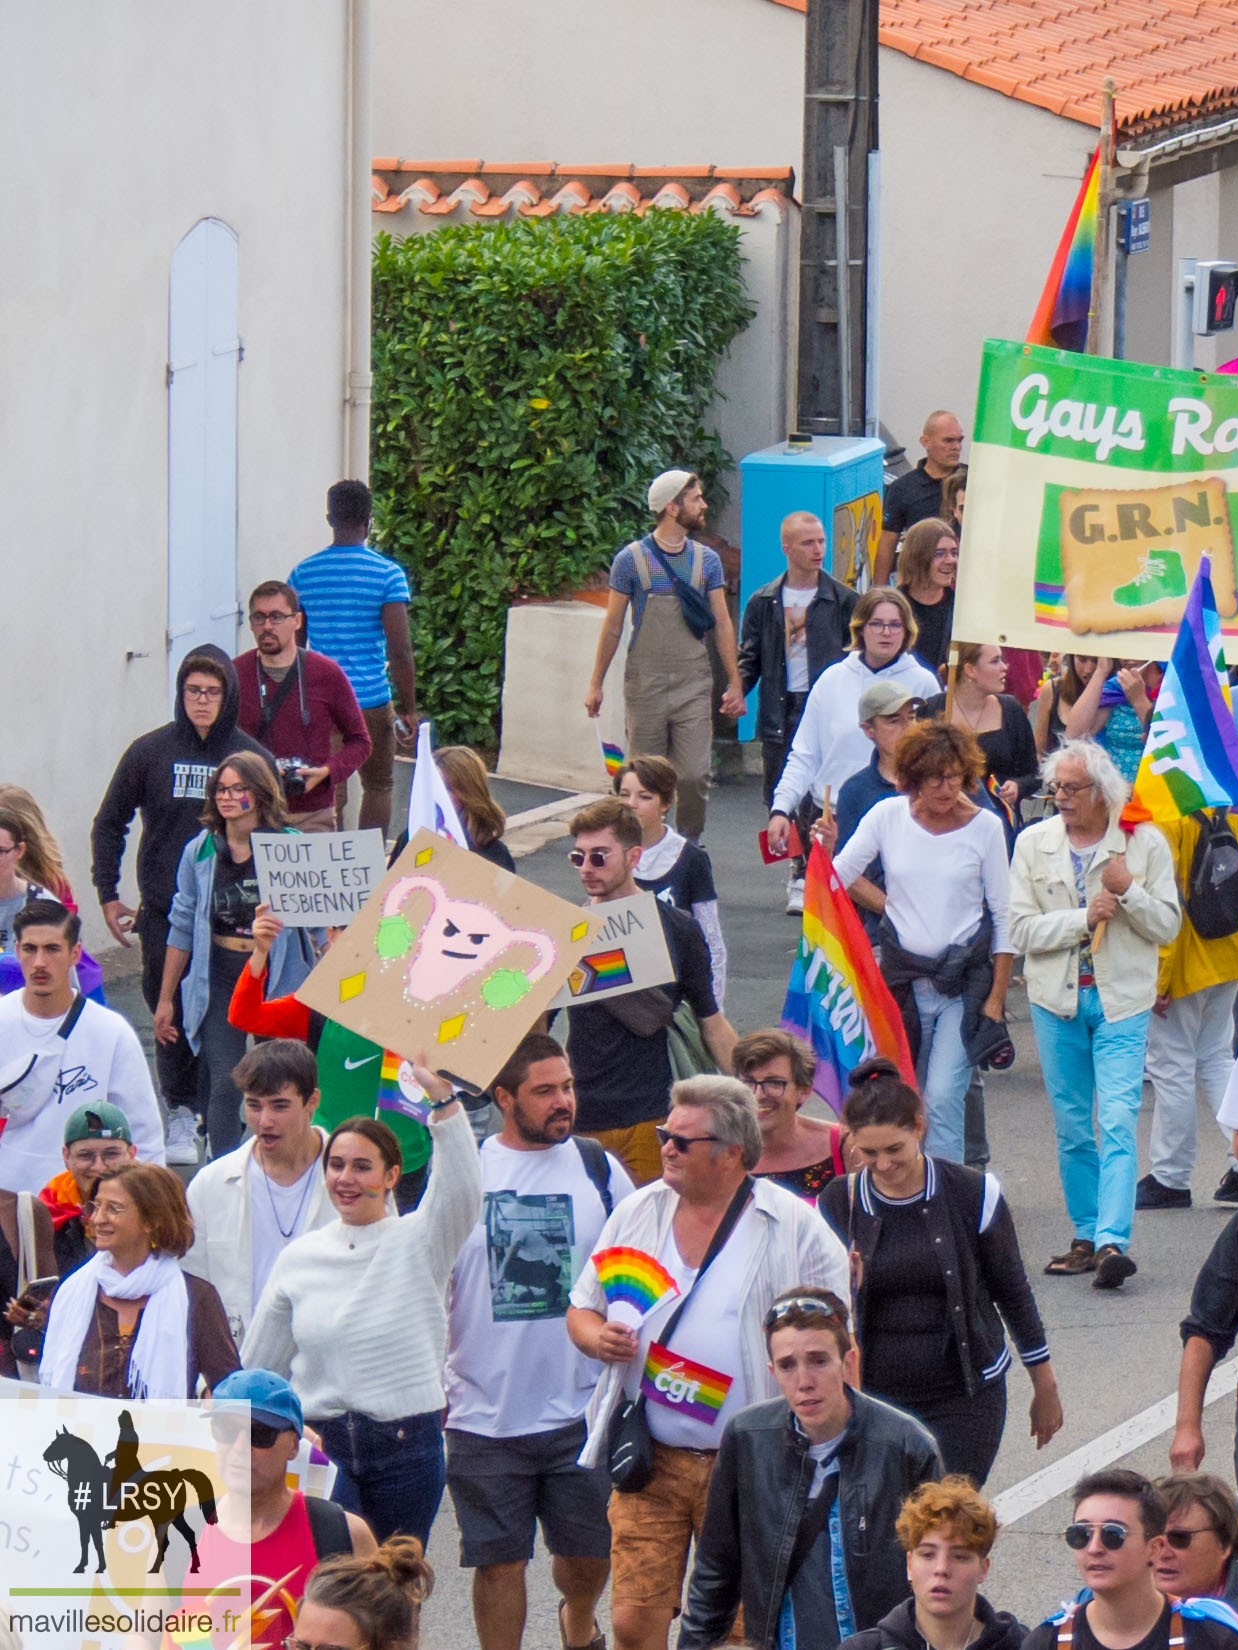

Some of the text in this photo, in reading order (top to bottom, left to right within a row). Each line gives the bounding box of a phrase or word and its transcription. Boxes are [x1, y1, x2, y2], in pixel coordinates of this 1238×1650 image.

[1010, 373, 1145, 461] Gays
[1069, 491, 1225, 544] G.R.N.
[259, 841, 356, 863] TOUT LE
[268, 870, 332, 889] MONDE
[340, 867, 371, 887] EST
[654, 1372, 702, 1404] cgt
